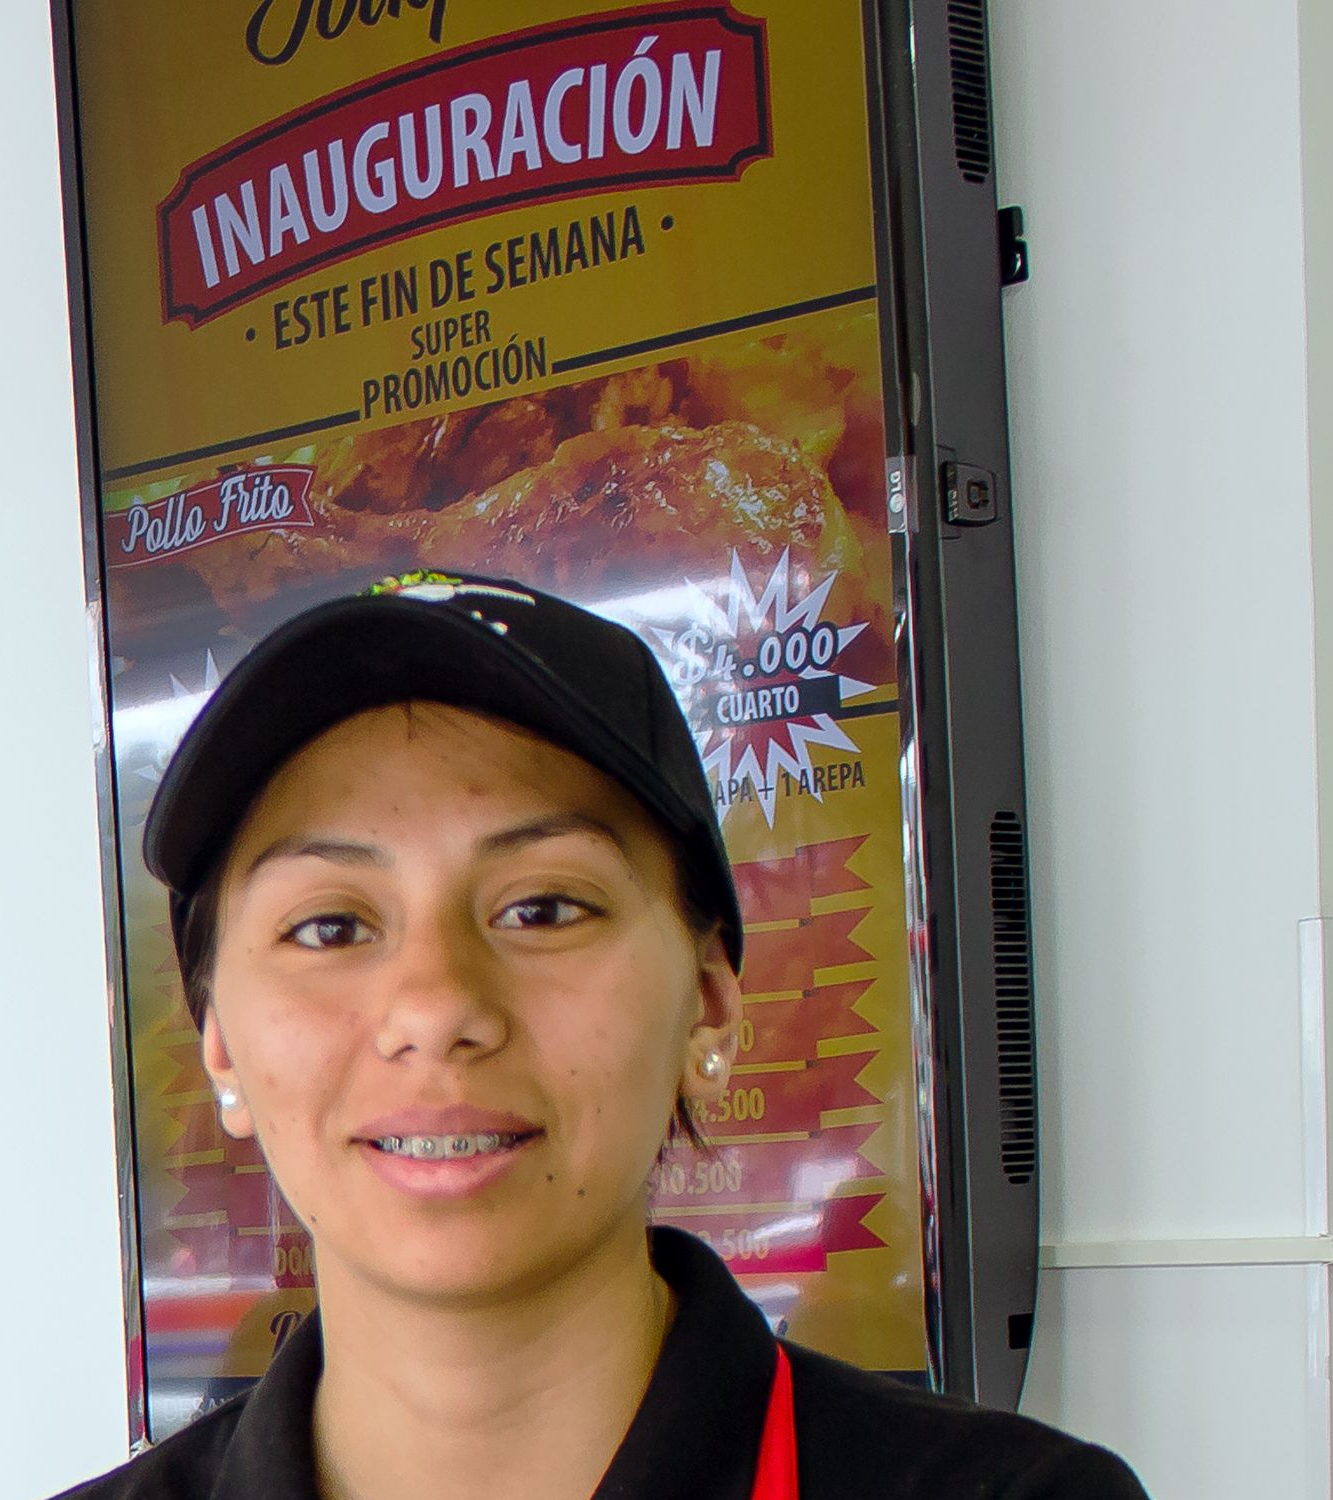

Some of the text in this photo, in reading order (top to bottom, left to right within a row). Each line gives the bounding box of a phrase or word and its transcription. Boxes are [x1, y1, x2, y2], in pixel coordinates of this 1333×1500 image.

[192, 36, 722, 288] INAUGURACIÓN
[273, 205, 646, 351] ESTE FIN DE SEMANA
[410, 309, 491, 361] SUPER
[363, 334, 547, 419] PROMOCIÓN
[121, 473, 294, 553] Pollo Frito
[671, 625, 837, 686] $4.000
[715, 684, 801, 724] CUARTO
[714, 776, 753, 806] APA
[797, 760, 866, 796] AREPA
